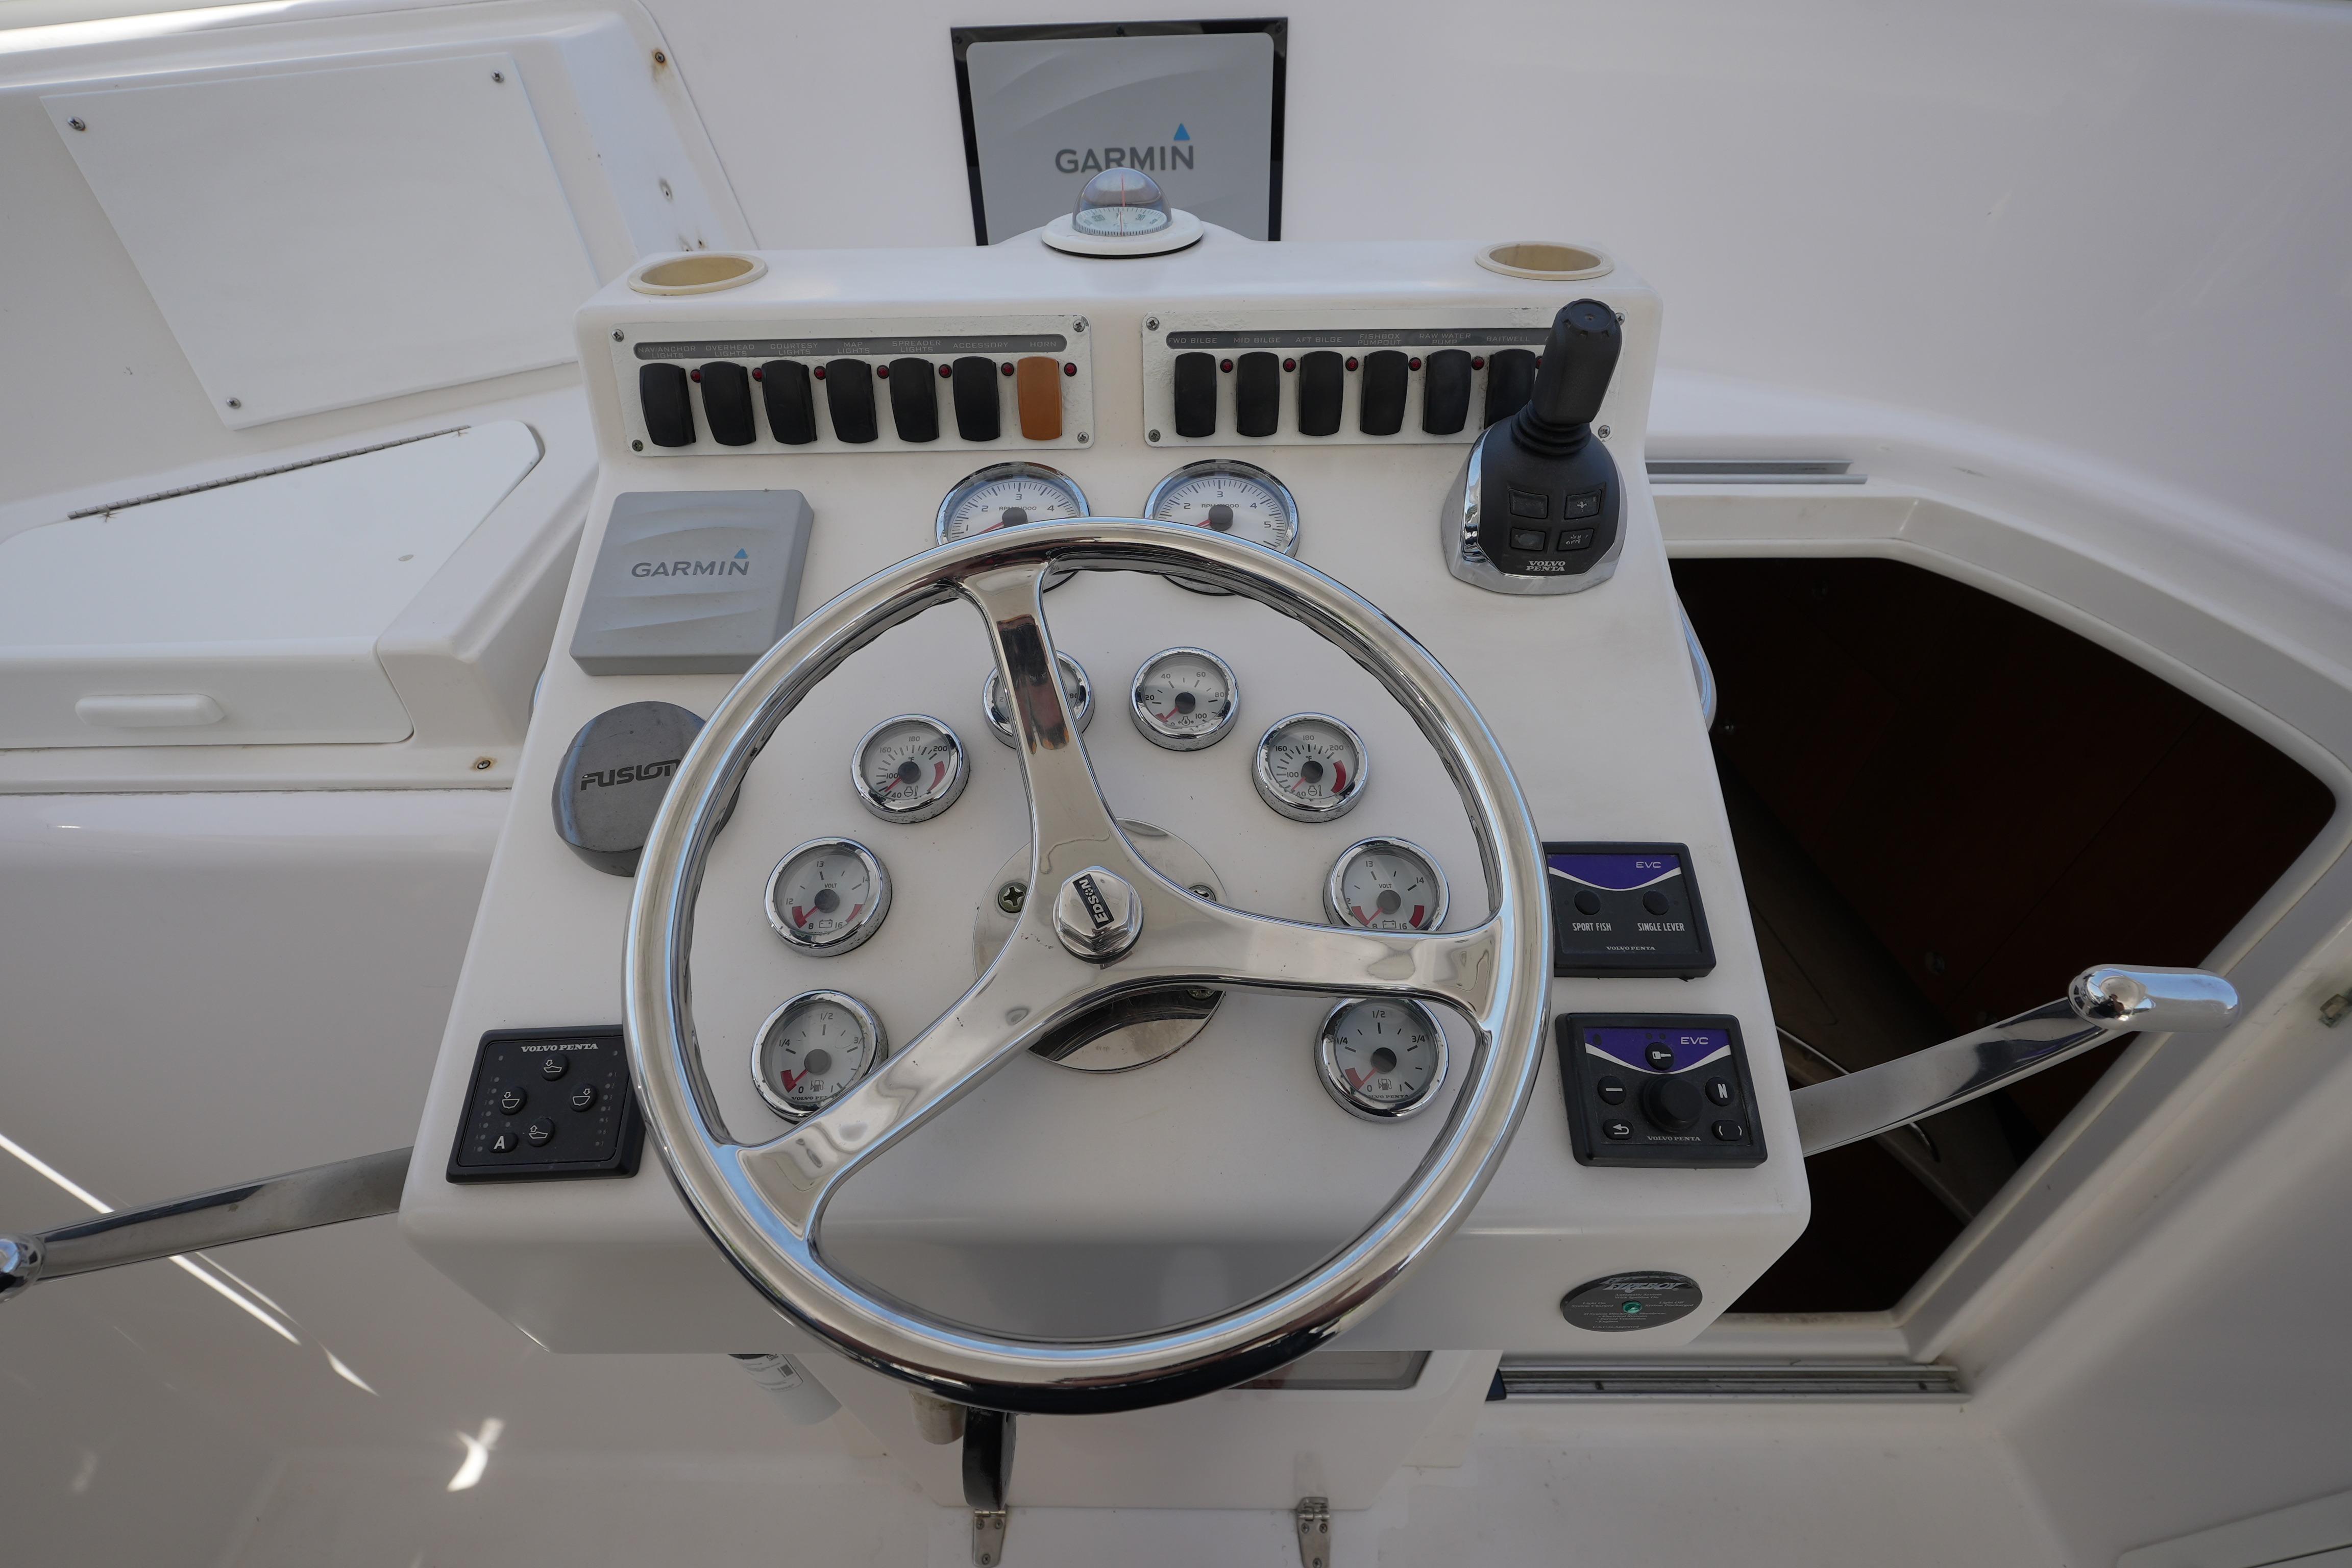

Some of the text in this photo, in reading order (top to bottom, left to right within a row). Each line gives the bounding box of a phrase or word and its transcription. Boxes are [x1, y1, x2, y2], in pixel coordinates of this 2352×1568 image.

[1055, 145, 1193, 174] GARMIN
[631, 561, 749, 578] GARMIN
[581, 759, 681, 791] FUSION
[1079, 879, 1109, 923] EDSON
[1572, 923, 1612, 931] SPORT FISH
[1637, 923, 1685, 932] SINGLE LEVER
[820, 1012, 833, 1021] 1/2
[1372, 1010, 1385, 1019] 1/2
[779, 1039, 790, 1047] 1/4
[1337, 1037, 1348, 1045] 1/4
[1412, 1035, 1425, 1043] 3/4
[1681, 1037, 1708, 1045] EVC
[1718, 1084, 1728, 1098] N
[494, 1136, 505, 1149] A
[1603, 1283, 1685, 1293] FIREBOY
